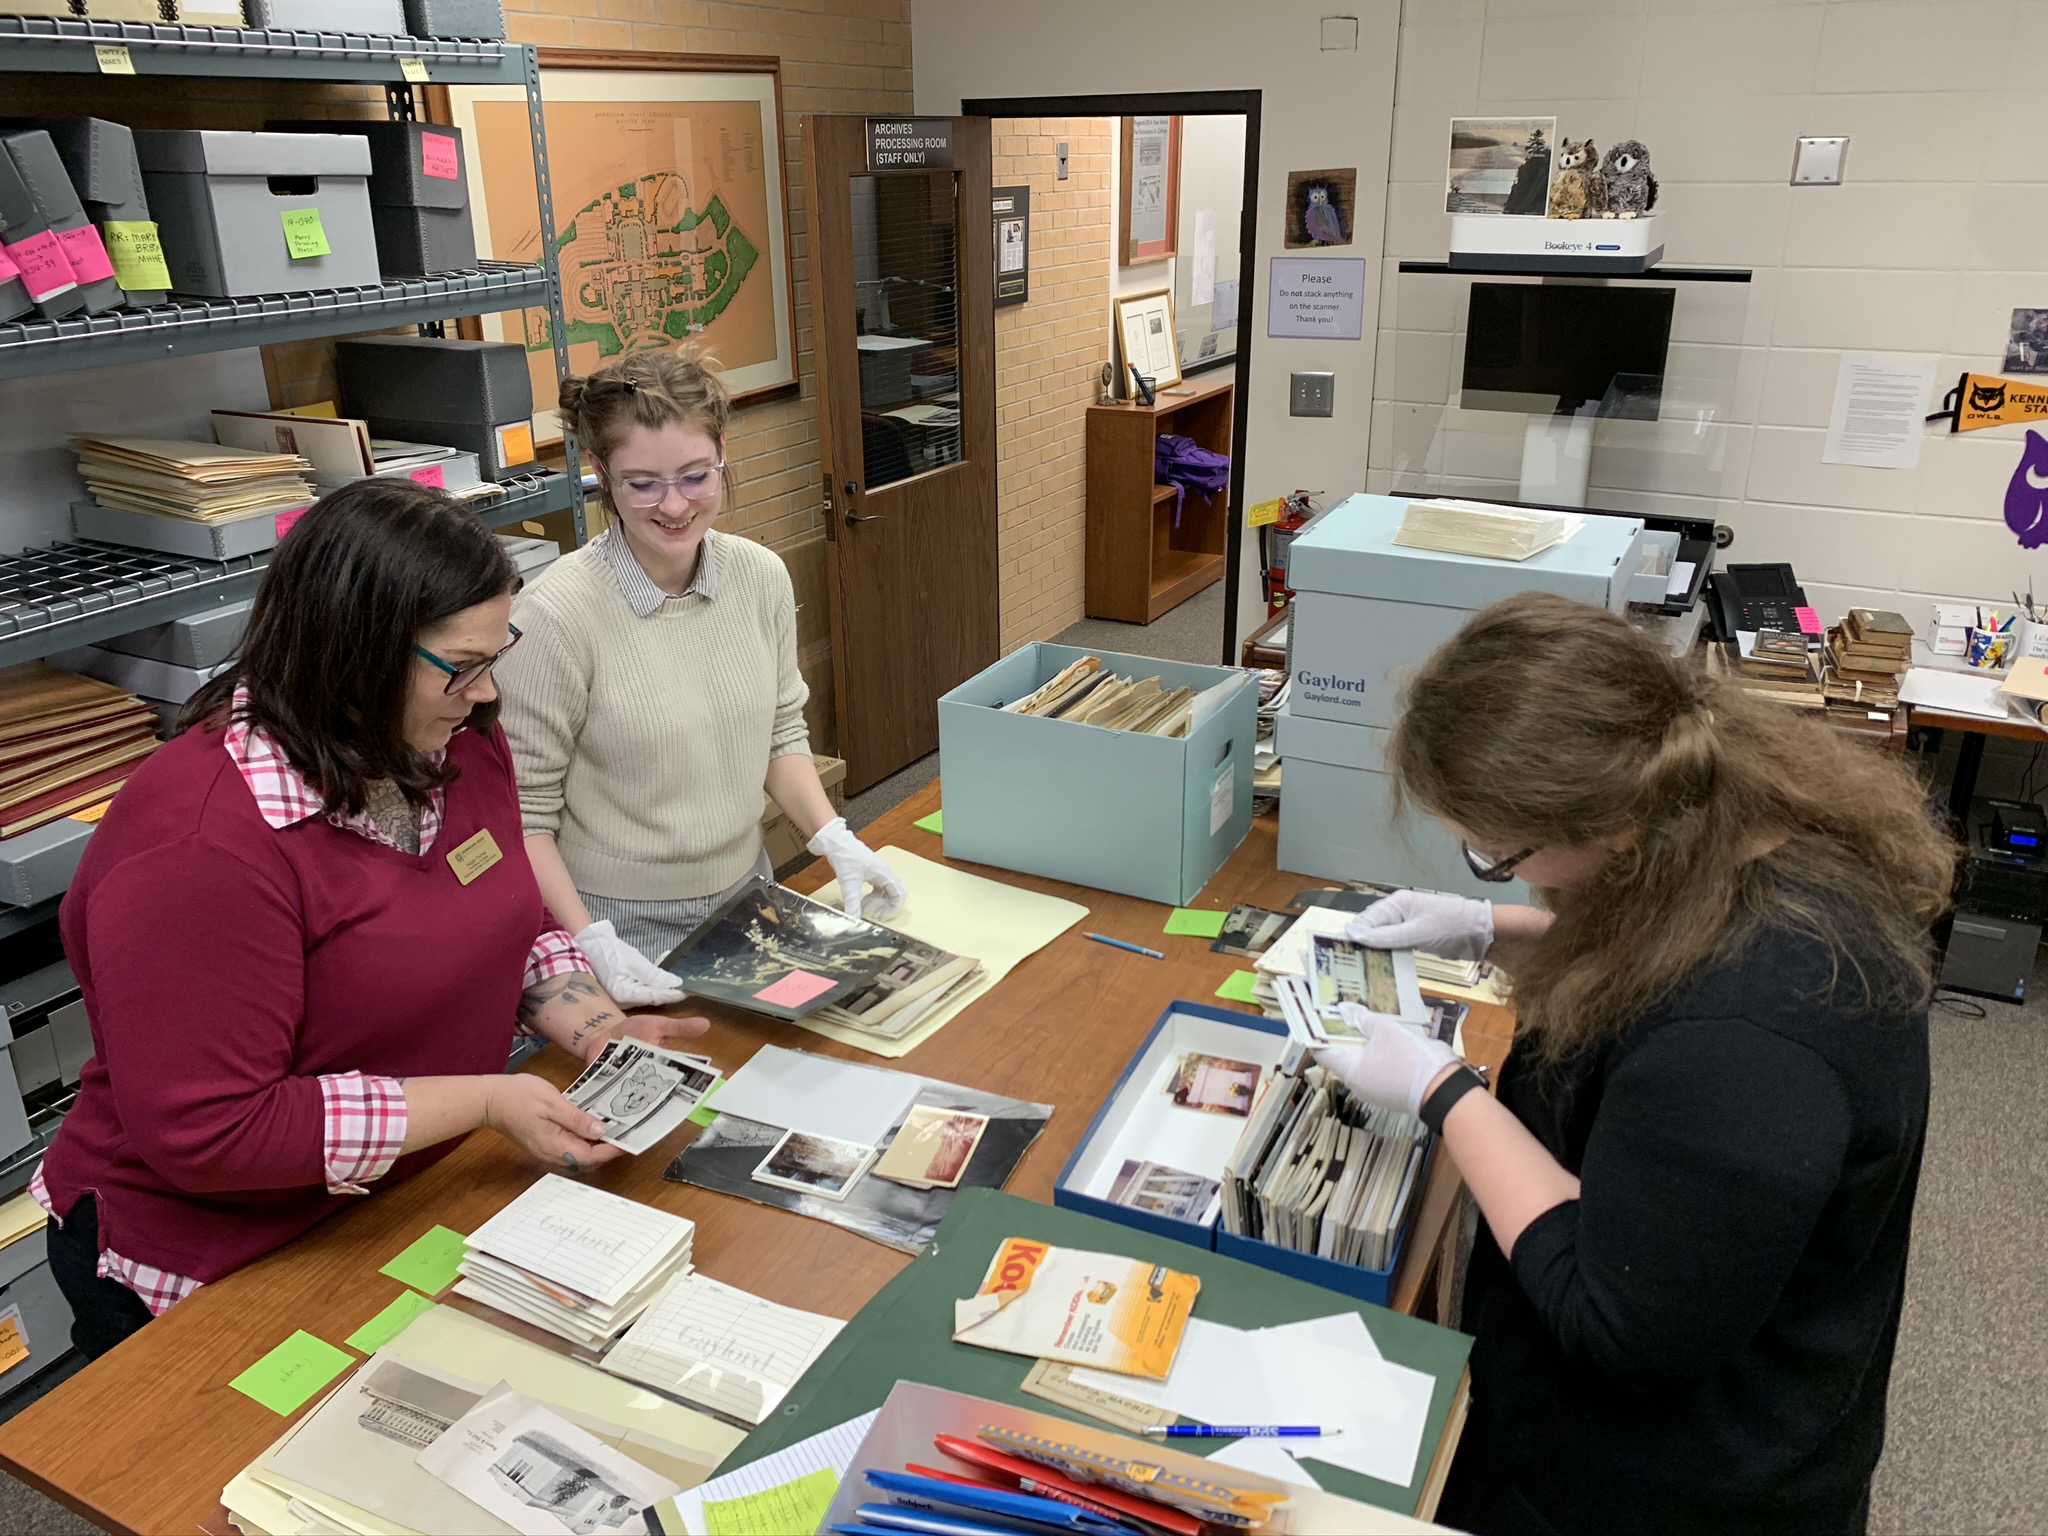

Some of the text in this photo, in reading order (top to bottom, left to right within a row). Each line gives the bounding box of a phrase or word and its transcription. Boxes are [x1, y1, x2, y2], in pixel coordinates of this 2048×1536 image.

[875, 123, 913, 134] ARCHIVES
[875, 137, 947, 149] PROCESSING ROOM
[876, 151, 925, 165] (STAFF ONLY)
[110, 232, 128, 242] RR:
[1544, 241, 1583, 252] Bookeye
[1585, 242, 1592, 250] 4
[1302, 273, 1332, 283] Please
[1279, 289, 1289, 297] Do
[1304, 290, 1322, 298] stack
[1323, 291, 1353, 299] anything
[1312, 303, 1342, 311] scanner.
[1296, 315, 1334, 324] Thank you!
[1298, 670, 1366, 693] Gaylord
[1304, 691, 1362, 707] Gaylord.com
[539, 1214, 627, 1257] Gaylord
[1053, 1313, 1074, 1349] Remember
[678, 1323, 776, 1373] Gaylord
[1107, 1395, 1155, 1416] MARBLE
[896, 1497, 934, 1511] Subject:
